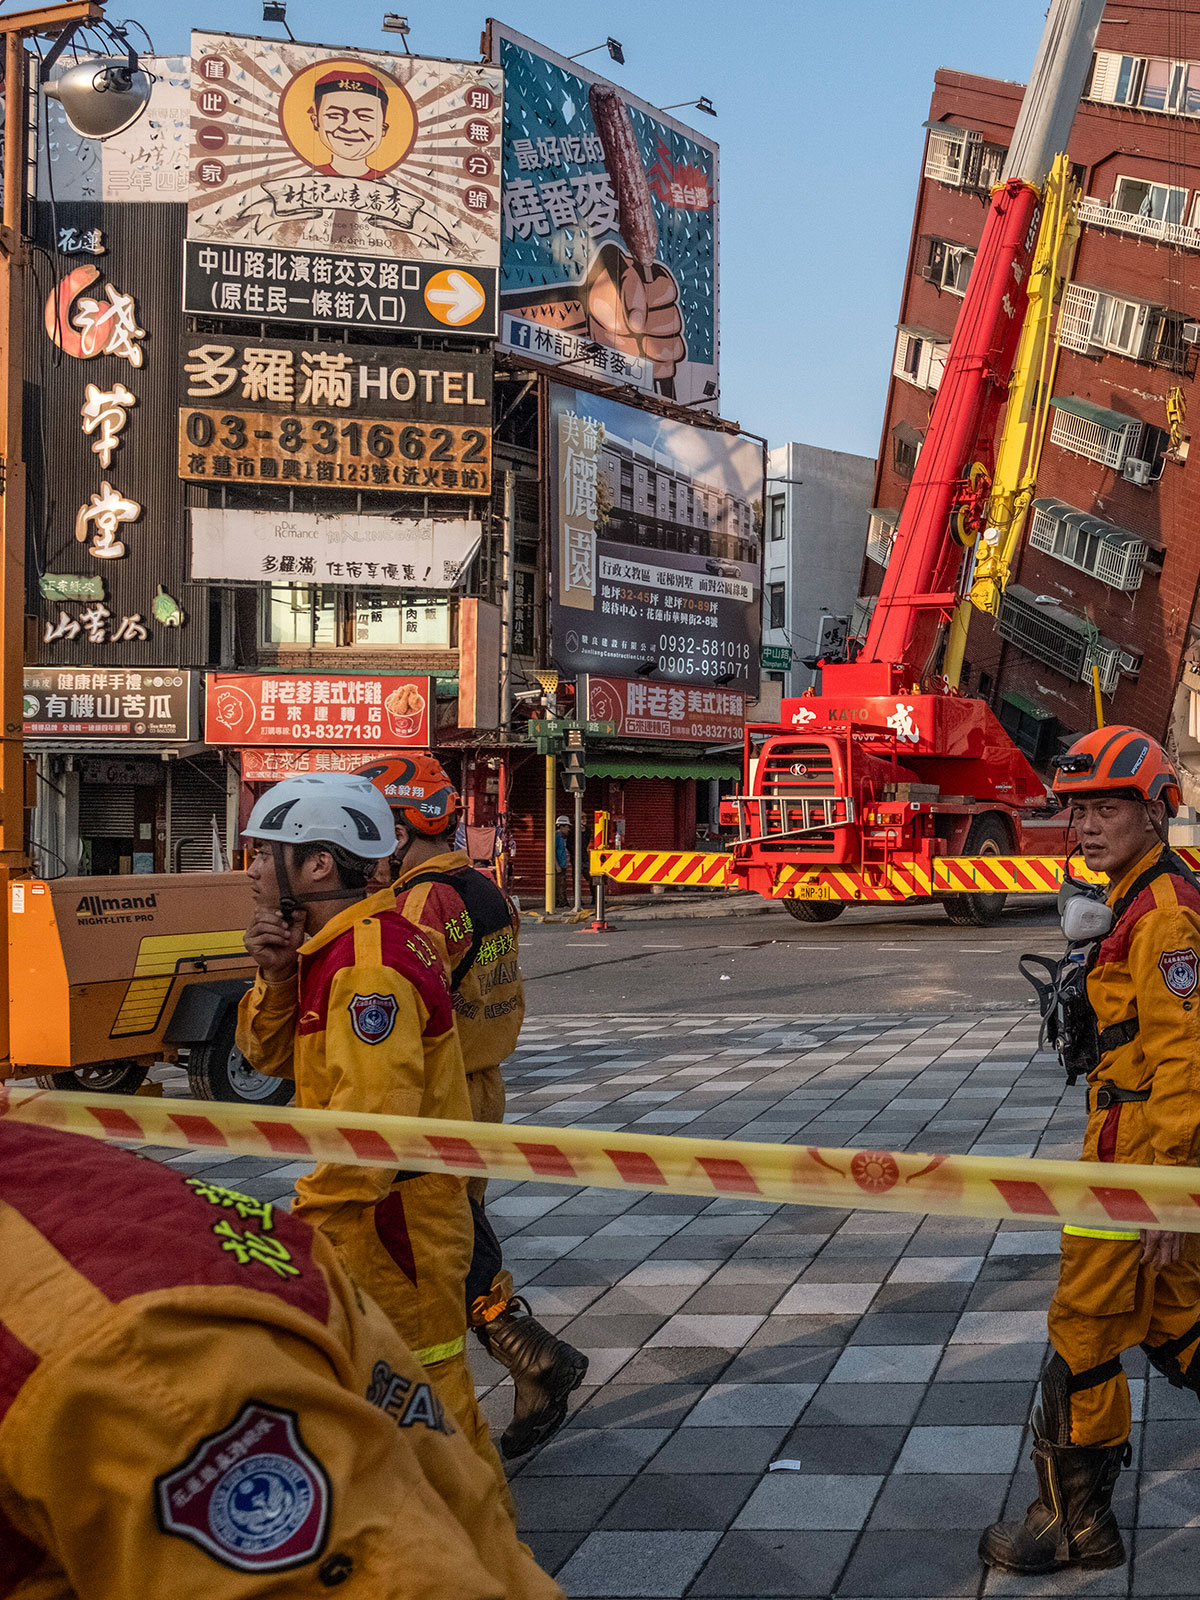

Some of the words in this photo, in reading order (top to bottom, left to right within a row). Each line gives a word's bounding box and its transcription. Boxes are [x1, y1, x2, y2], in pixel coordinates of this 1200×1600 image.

[203, 60, 225, 183] 僅此一家
[468, 91, 490, 209] 別無分號
[513, 132, 607, 173] 最好吃的
[502, 171, 621, 242] 燒番麥
[58, 227, 104, 255] 花蓮
[368, 238, 392, 249] BBQ
[198, 247, 421, 291] 中山路北濱街交叉路口
[211, 281, 407, 323] (原住民一條街入口)
[534, 325, 627, 376] 林記燒番麥
[184, 344, 353, 409] 多羅滿
[358, 365, 487, 407] HOTEL
[186, 411, 489, 464] 03-8316622
[262, 554, 317, 576] 多羅滿
[43, 602, 148, 644] 山苦瓜
[659, 633, 751, 661] 0932-581018
[763, 648, 790, 660] 中山路
[657, 655, 750, 680] 0905-935071
[57, 673, 142, 690] 健康伴手禮
[261, 680, 383, 705] 胖老爹美式炸雞
[45, 693, 172, 719] 有機山苦瓜
[828, 708, 869, 721] KATO
[291, 723, 382, 740] 03-8327130
[690, 723, 744, 740] 03-8327130
[264, 752, 311, 771] 石來店
[76, 893, 157, 916] Allmand
[77, 915, 132, 926] NIGHT-LITE
[134, 914, 155, 923] PRO
[366, 1359, 458, 1436] SEA
